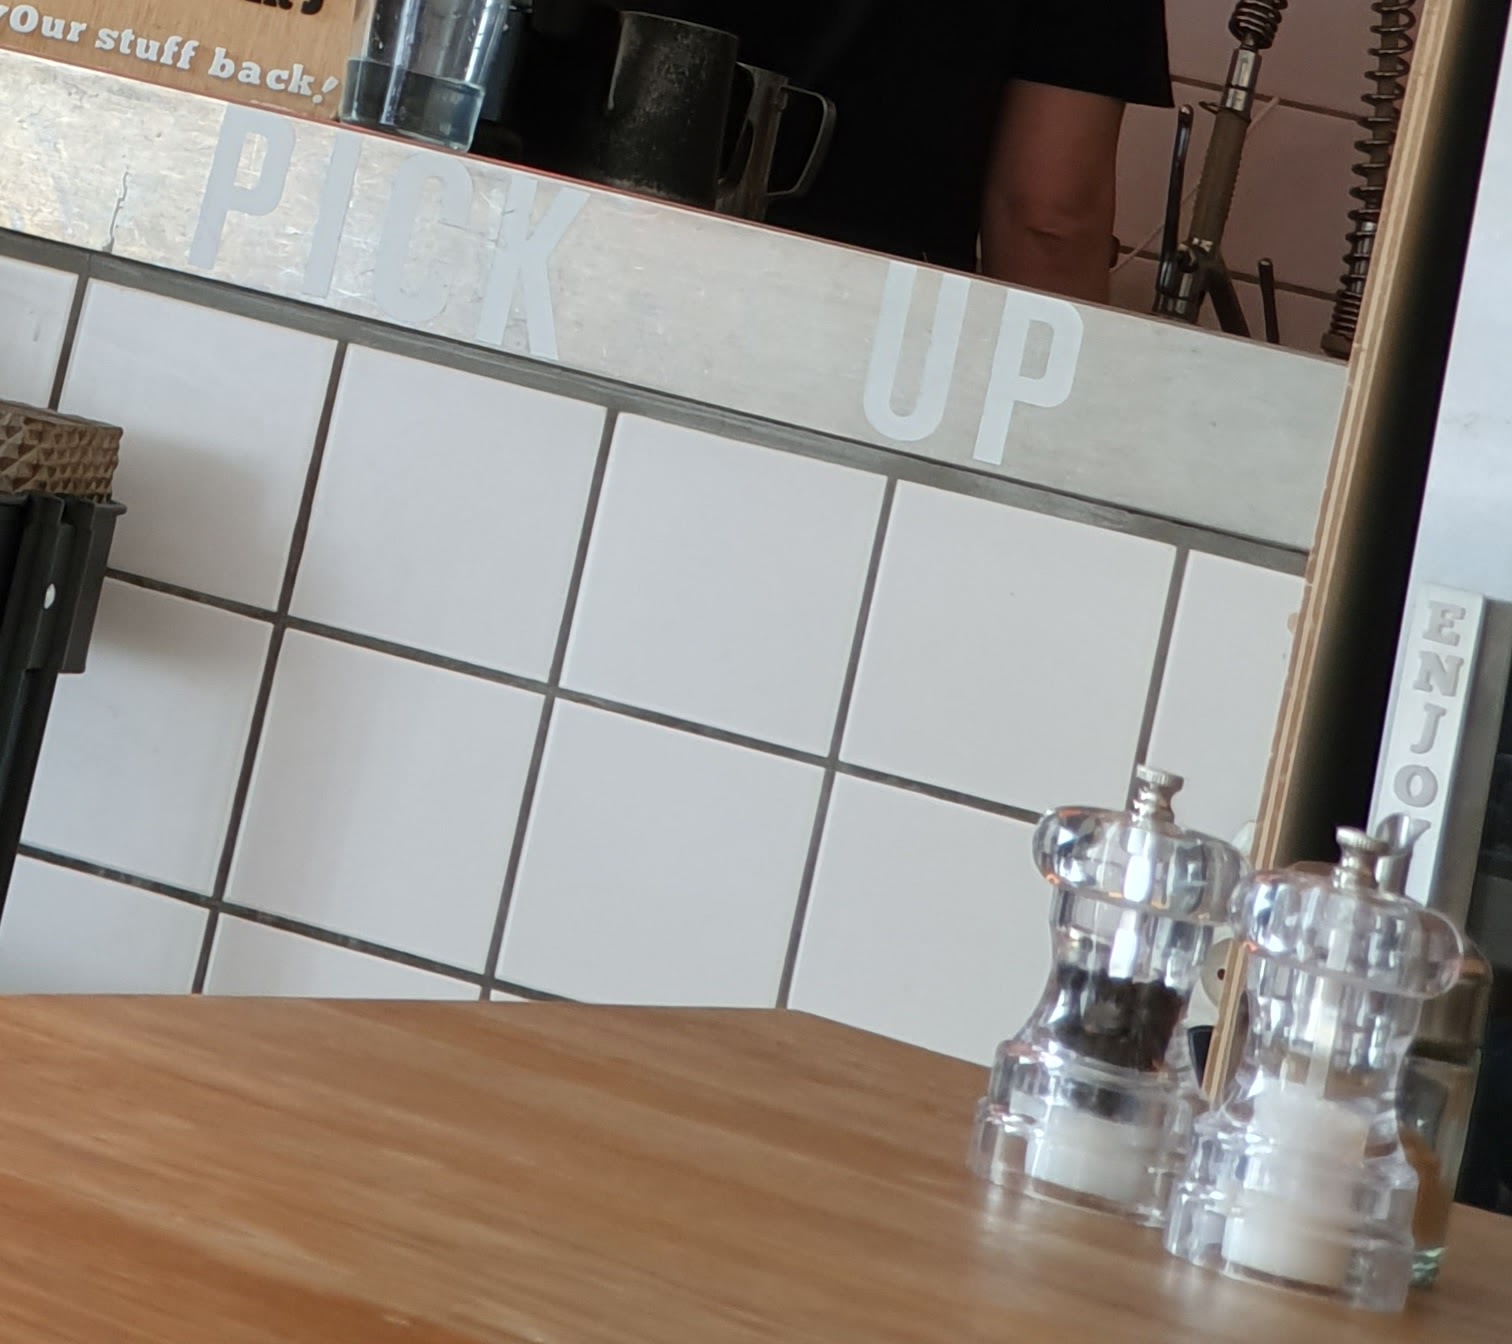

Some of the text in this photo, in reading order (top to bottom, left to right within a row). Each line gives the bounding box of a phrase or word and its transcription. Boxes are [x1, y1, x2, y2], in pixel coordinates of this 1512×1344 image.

[94, 26, 200, 72] stuff
[208, 46, 338, 105] back!
[189, 101, 1084, 465] PICK UP
